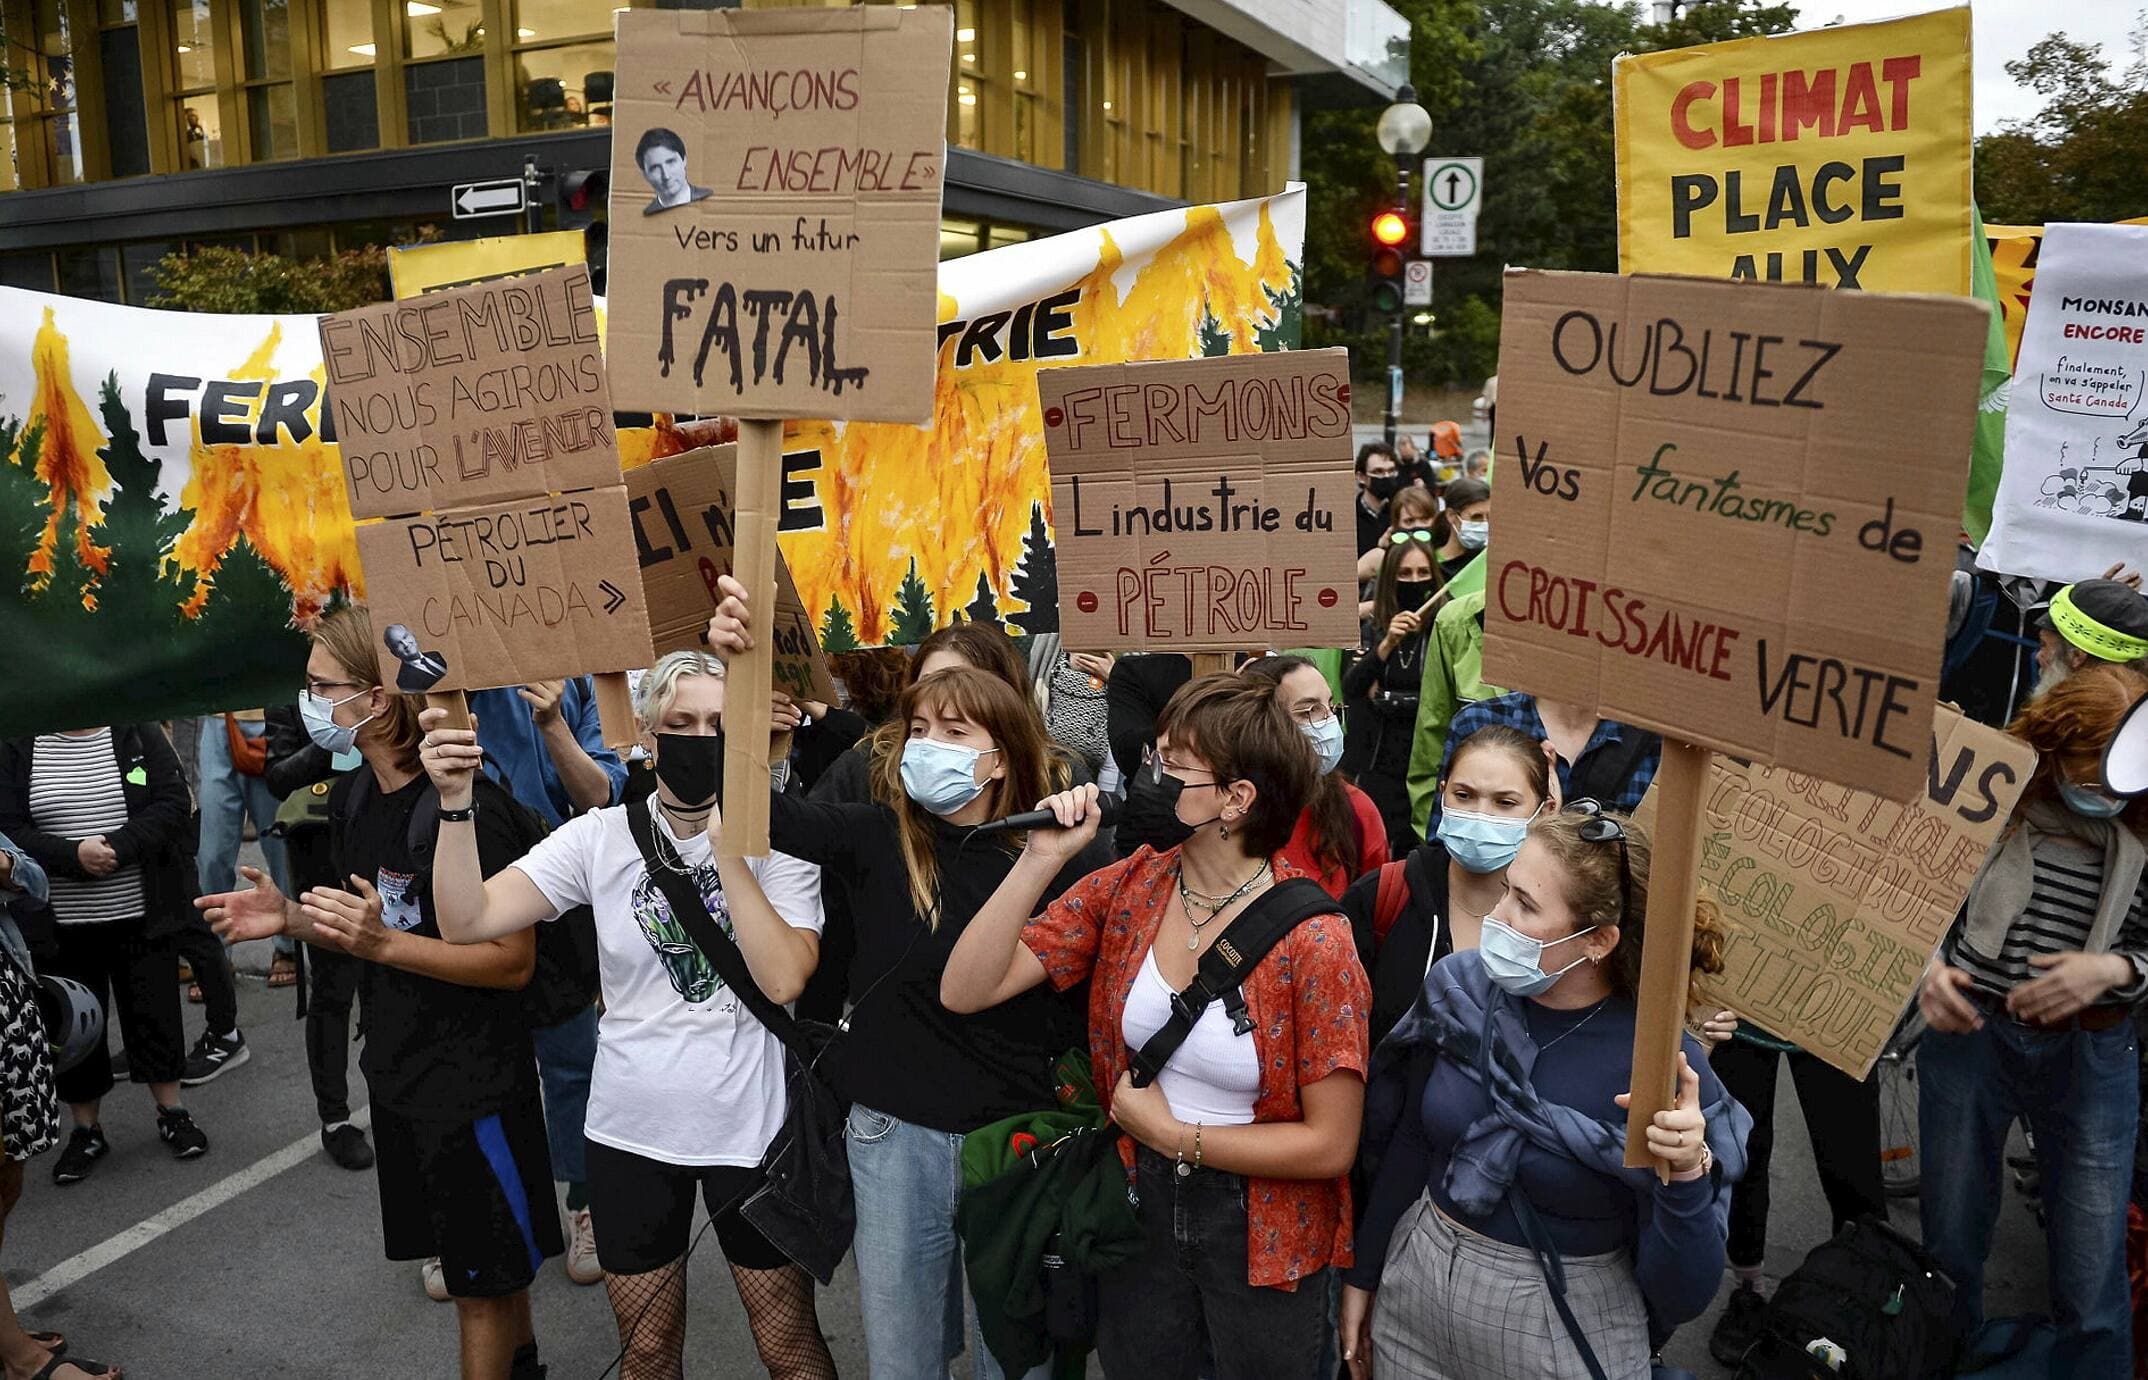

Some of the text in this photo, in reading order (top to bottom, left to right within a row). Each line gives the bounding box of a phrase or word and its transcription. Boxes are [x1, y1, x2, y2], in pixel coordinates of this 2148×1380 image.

[1670, 55, 1921, 150] CLIMAT
[674, 217, 860, 253] Vers un futur
[1671, 155, 1905, 239] PLACE
[319, 273, 598, 385] ENSEMBLE
[658, 278, 869, 395] FATAL
[1552, 310, 1842, 409] OUBLIEZ
[2063, 324, 2145, 344] ENCORE
[145, 373, 338, 446] FER
[340, 354, 599, 437] NOUS AGIRONS
[1063, 373, 1350, 450] FERMONS
[2065, 377, 2076, 385] va
[2086, 394, 2127, 408] Canada
[350, 406, 611, 500] POUR L'AVENIR
[408, 502, 594, 567] PÉTROLIER
[1295, 487, 1332, 532] du
[1516, 435, 1922, 563] Vos fantasmes de
[486, 556, 526, 588] DU
[1117, 550, 1307, 637] PÉTROLE
[1498, 559, 1918, 759] CROISSANCE VERTE
